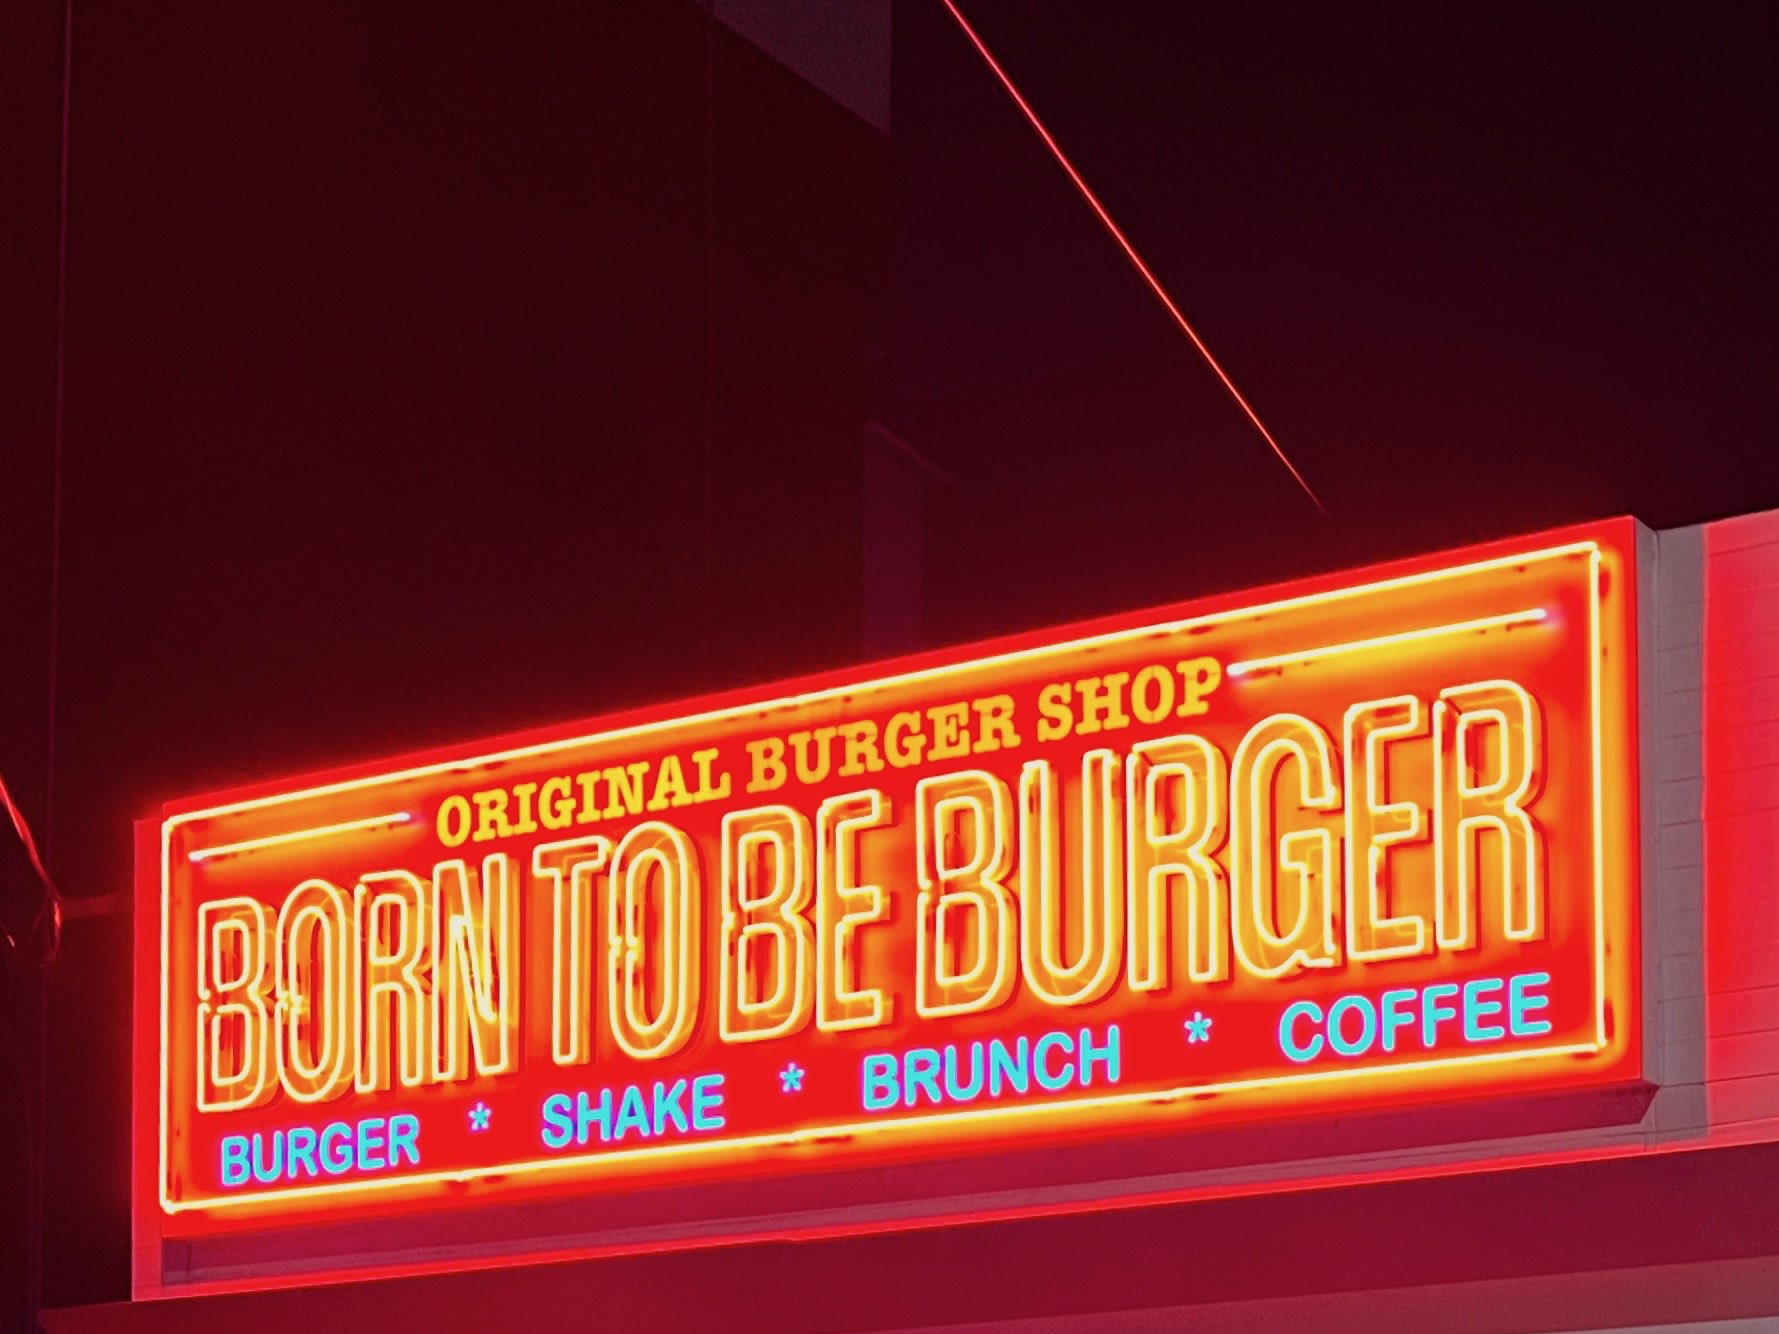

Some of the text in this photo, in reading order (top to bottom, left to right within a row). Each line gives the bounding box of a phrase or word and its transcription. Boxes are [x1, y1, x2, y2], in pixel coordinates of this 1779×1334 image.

[435, 657, 1222, 846] ORIGINAL BURGER SHOP
[197, 678, 1548, 1112] BORN TO BE BURGER
[220, 971, 1552, 1189] BURGER SHAKE BRUNCH COFFEE
